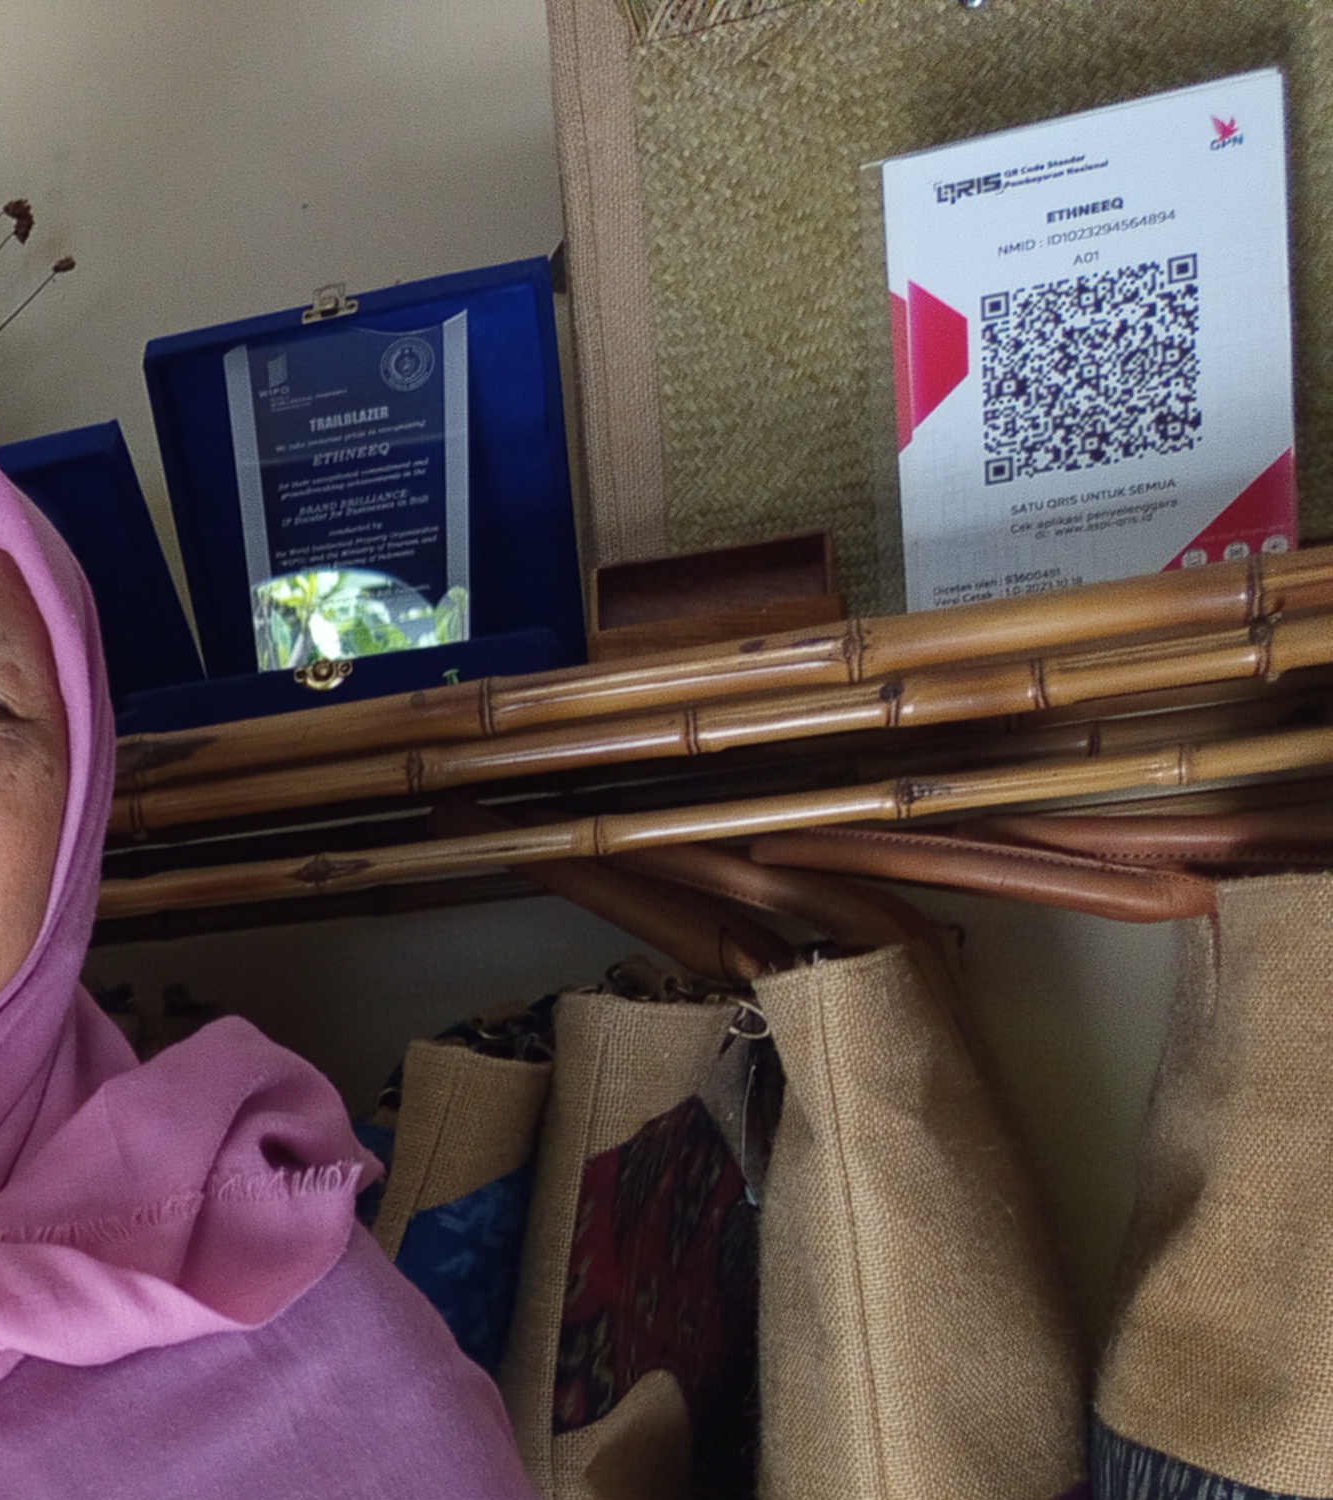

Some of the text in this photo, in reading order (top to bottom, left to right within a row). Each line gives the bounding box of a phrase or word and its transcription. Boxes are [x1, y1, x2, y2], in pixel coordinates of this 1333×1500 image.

[935, 172, 1002, 206] QRIS
[1045, 196, 1124, 225] ETHNEEQ
[997, 239, 1035, 256] NMID
[1072, 250, 1099, 265] A01
[308, 406, 389, 431] TRAILBLAZER
[311, 442, 391, 466] ETHNEEQ
[1010, 478, 1176, 514] SATU QRIS UNTUK SEMUA
[1010, 522, 1032, 533] Cek
